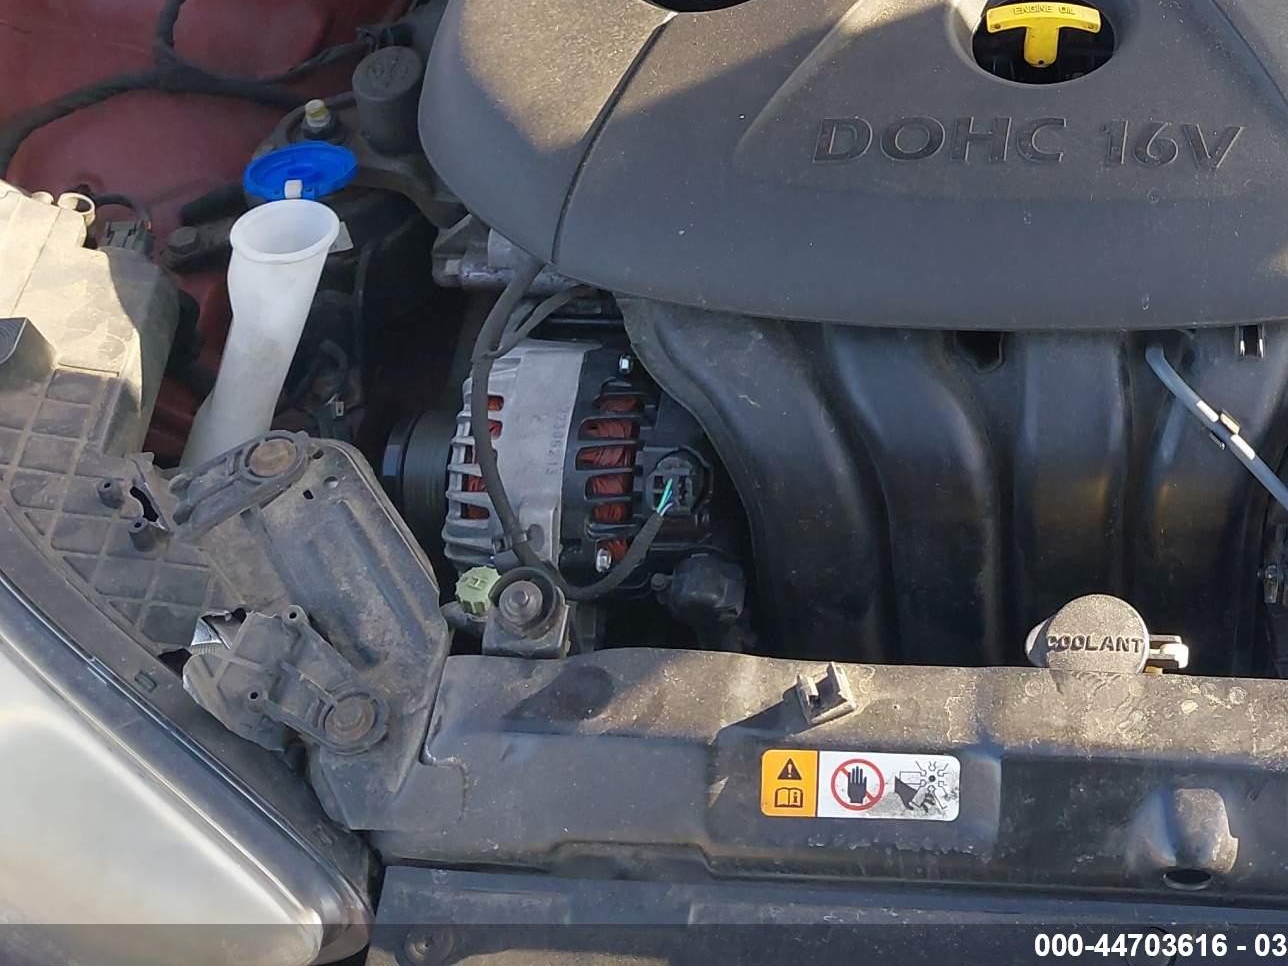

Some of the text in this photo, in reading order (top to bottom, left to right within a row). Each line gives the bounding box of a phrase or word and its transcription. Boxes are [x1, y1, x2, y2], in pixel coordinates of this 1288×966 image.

[1013, 4, 1077, 16] ENGINE OIL
[812, 116, 1245, 171] DOHC 16V
[1047, 634, 1144, 654] COOLANT
